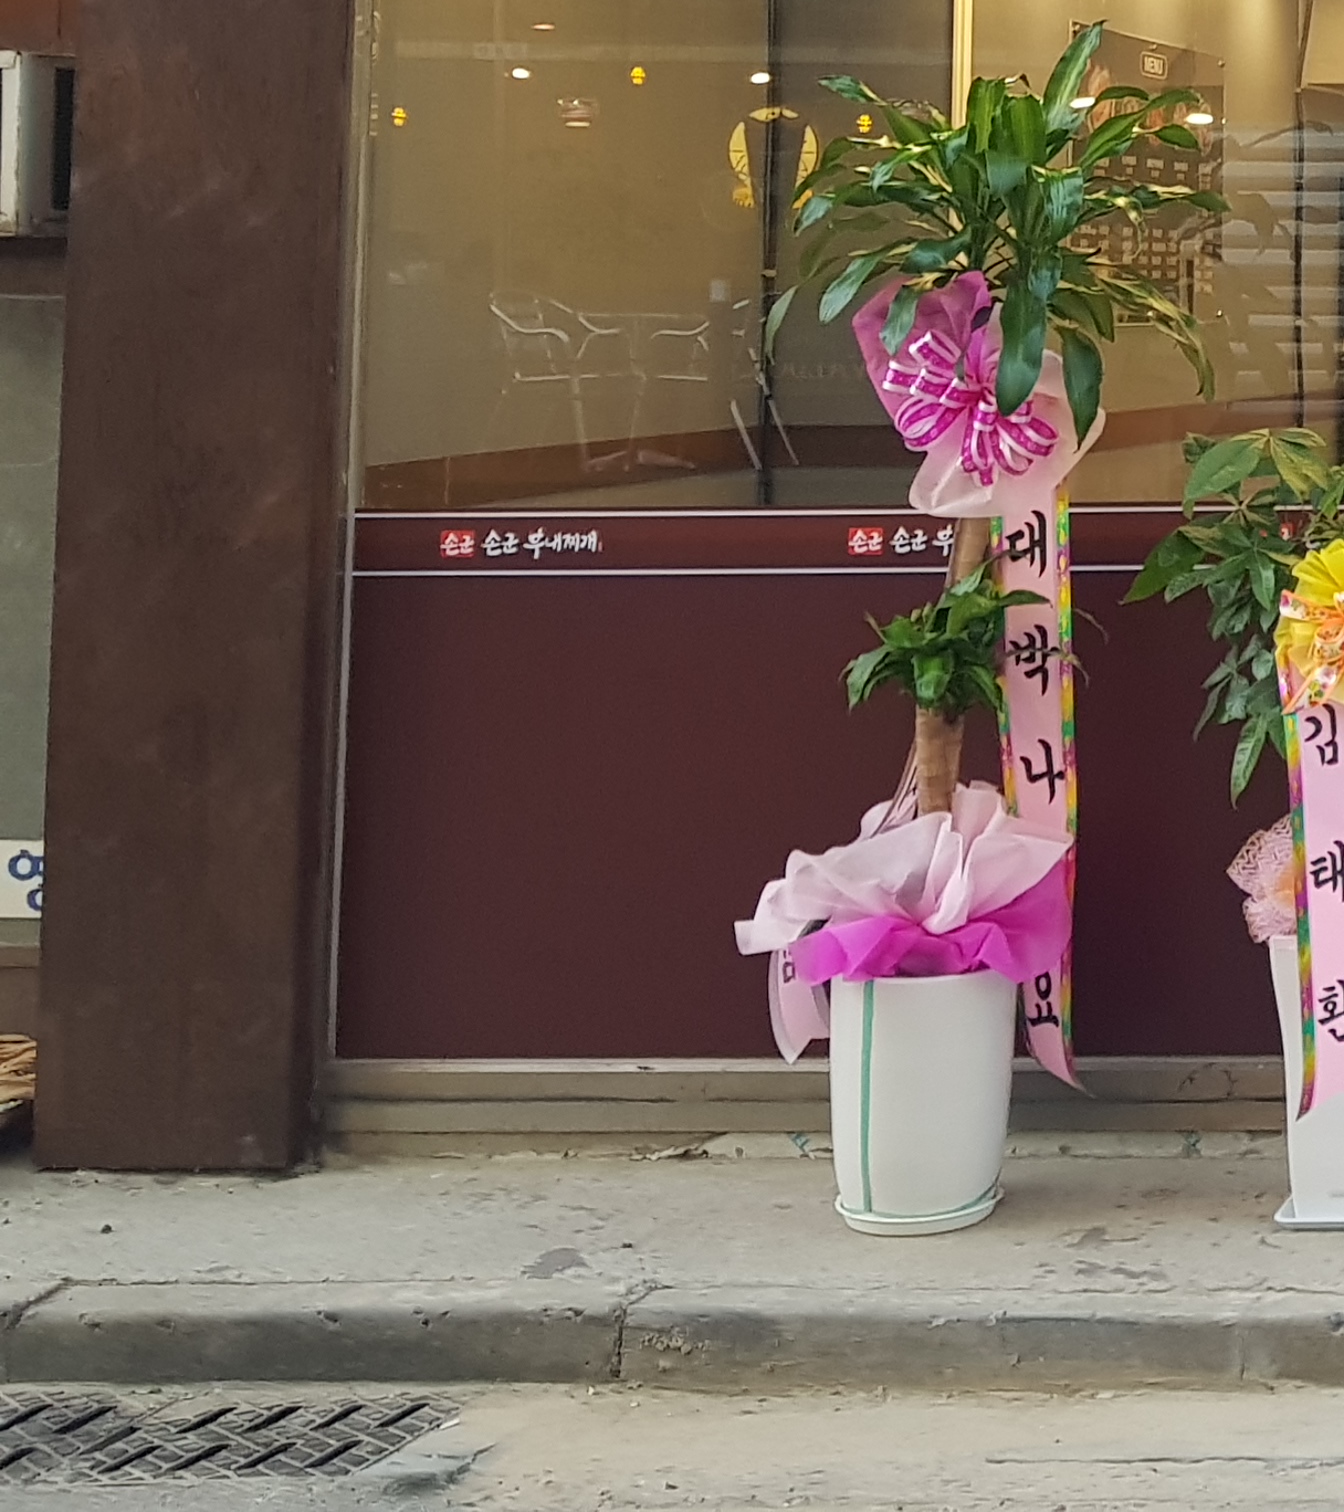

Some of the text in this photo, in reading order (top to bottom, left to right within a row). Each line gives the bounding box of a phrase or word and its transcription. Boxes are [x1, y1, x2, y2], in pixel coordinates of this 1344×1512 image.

[440, 532, 475, 556] 손군
[480, 528, 520, 557] 손군
[848, 528, 884, 554] 손군
[889, 525, 928, 554] 손군
